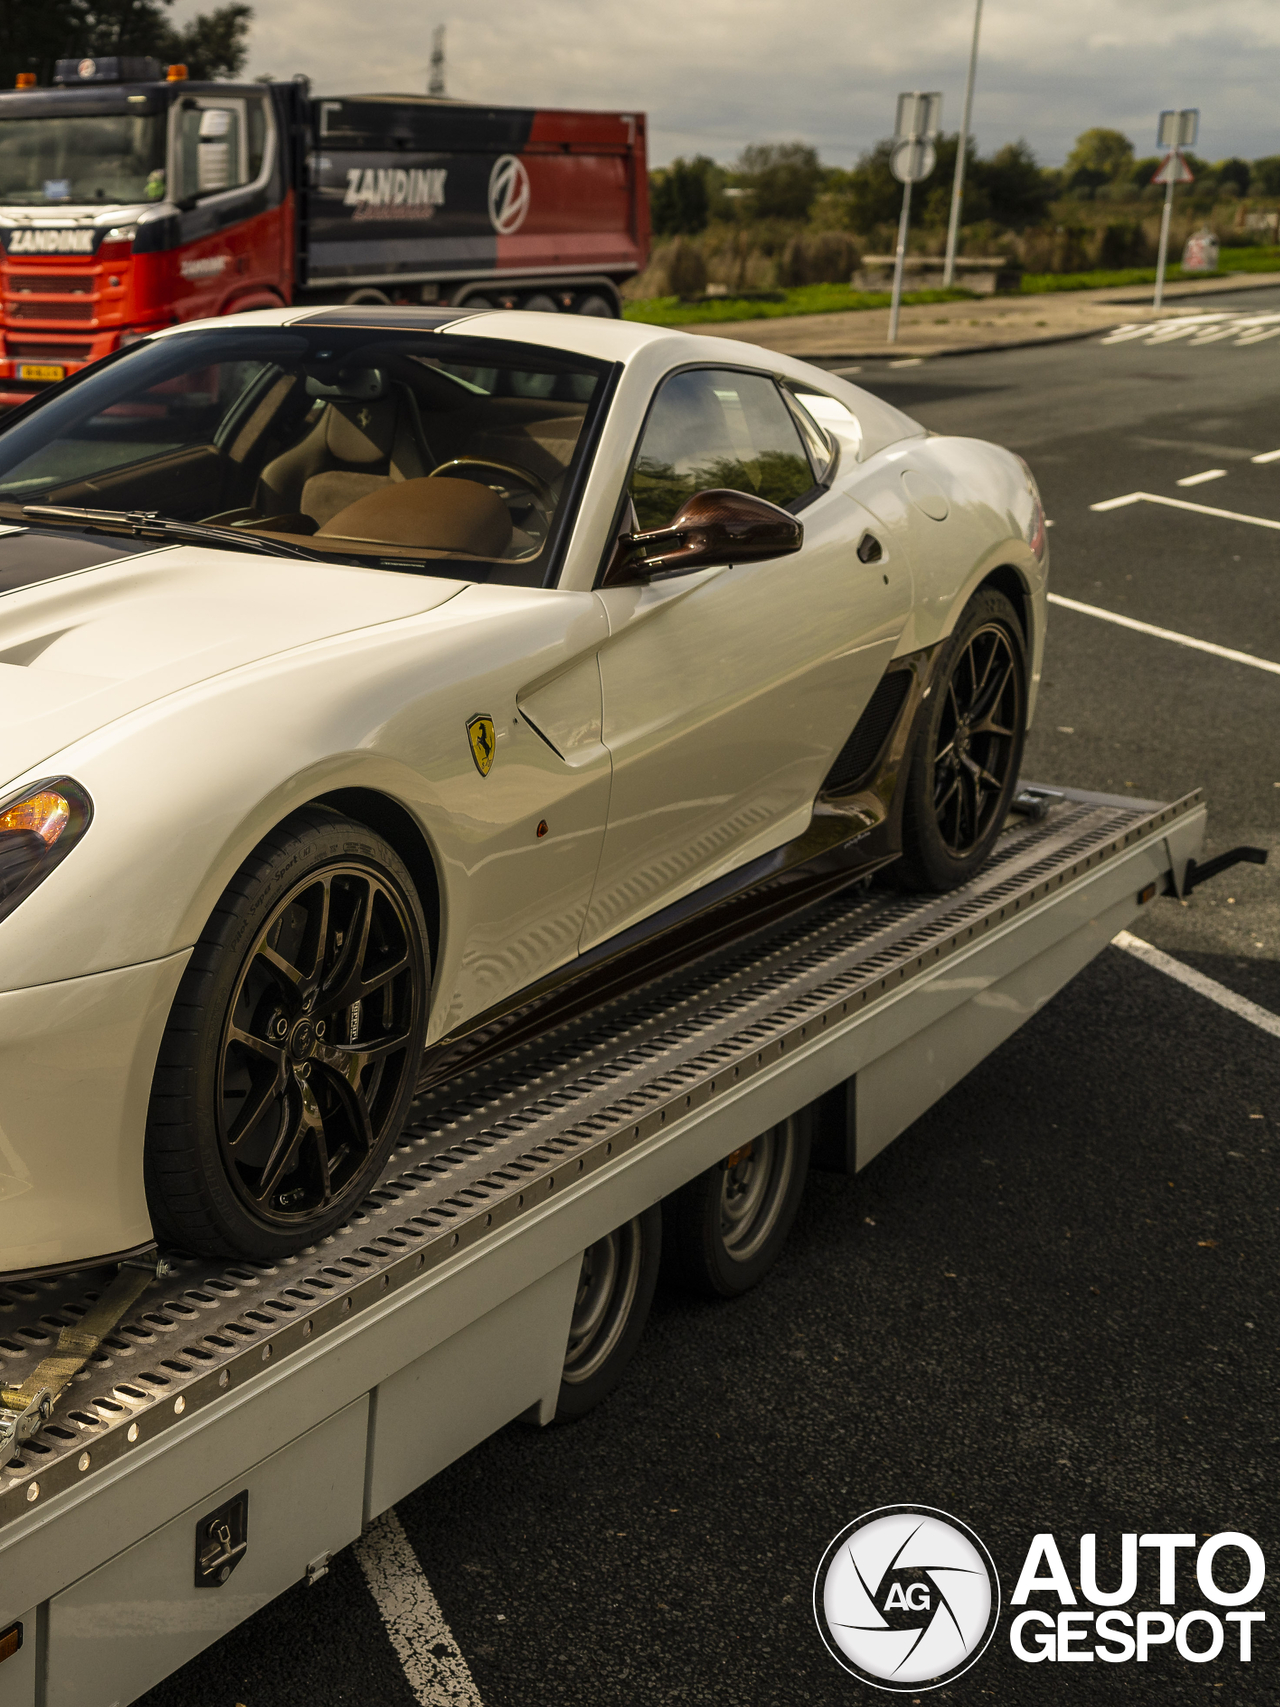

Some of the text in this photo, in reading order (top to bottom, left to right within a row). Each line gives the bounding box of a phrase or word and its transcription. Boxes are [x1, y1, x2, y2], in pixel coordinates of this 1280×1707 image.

[342, 168, 448, 206] ZANDINK
[8, 229, 95, 253] ZANDINK
[247, 882, 272, 916] Super
[271, 855, 299, 882] Sport
